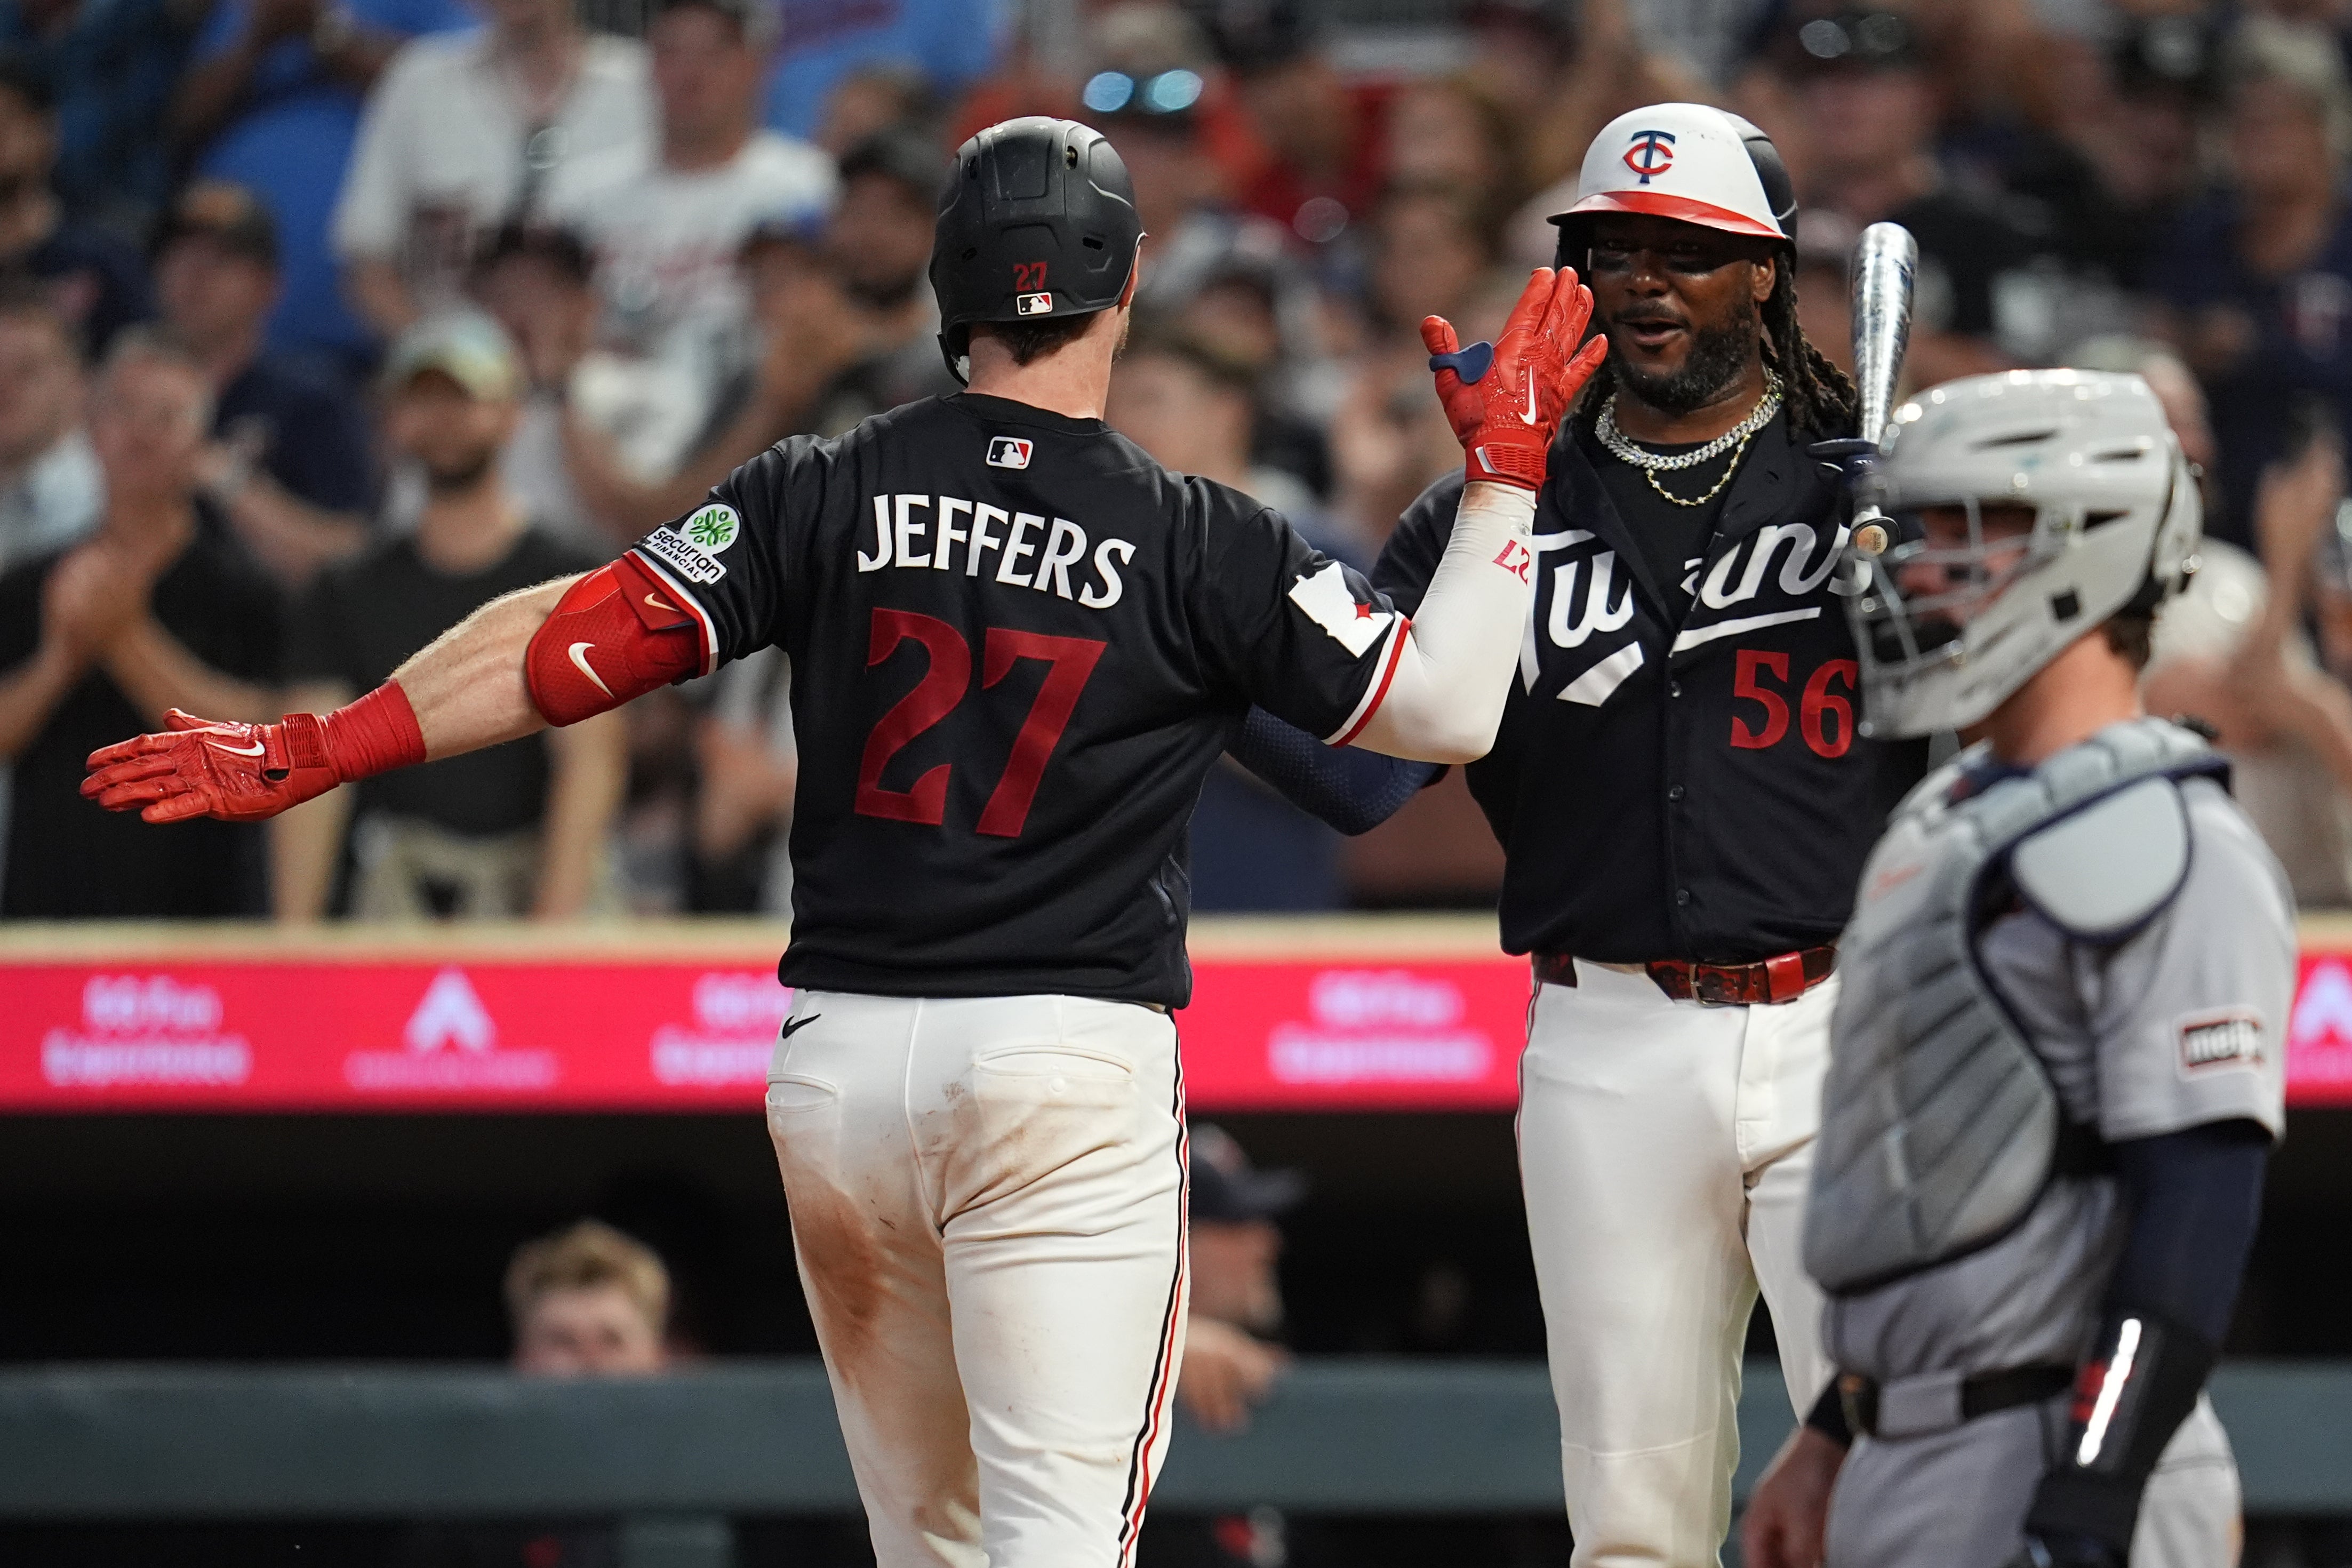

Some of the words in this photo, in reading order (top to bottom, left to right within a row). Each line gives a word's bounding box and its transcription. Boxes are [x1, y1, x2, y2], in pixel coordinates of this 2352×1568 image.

[1014, 261, 1047, 291] 27
[652, 542, 700, 578] FINANCIAL
[653, 530, 720, 579] securian
[857, 494, 1136, 609] JEFFERS
[854, 606, 1108, 837] 27
[1730, 649, 1859, 758] 56
